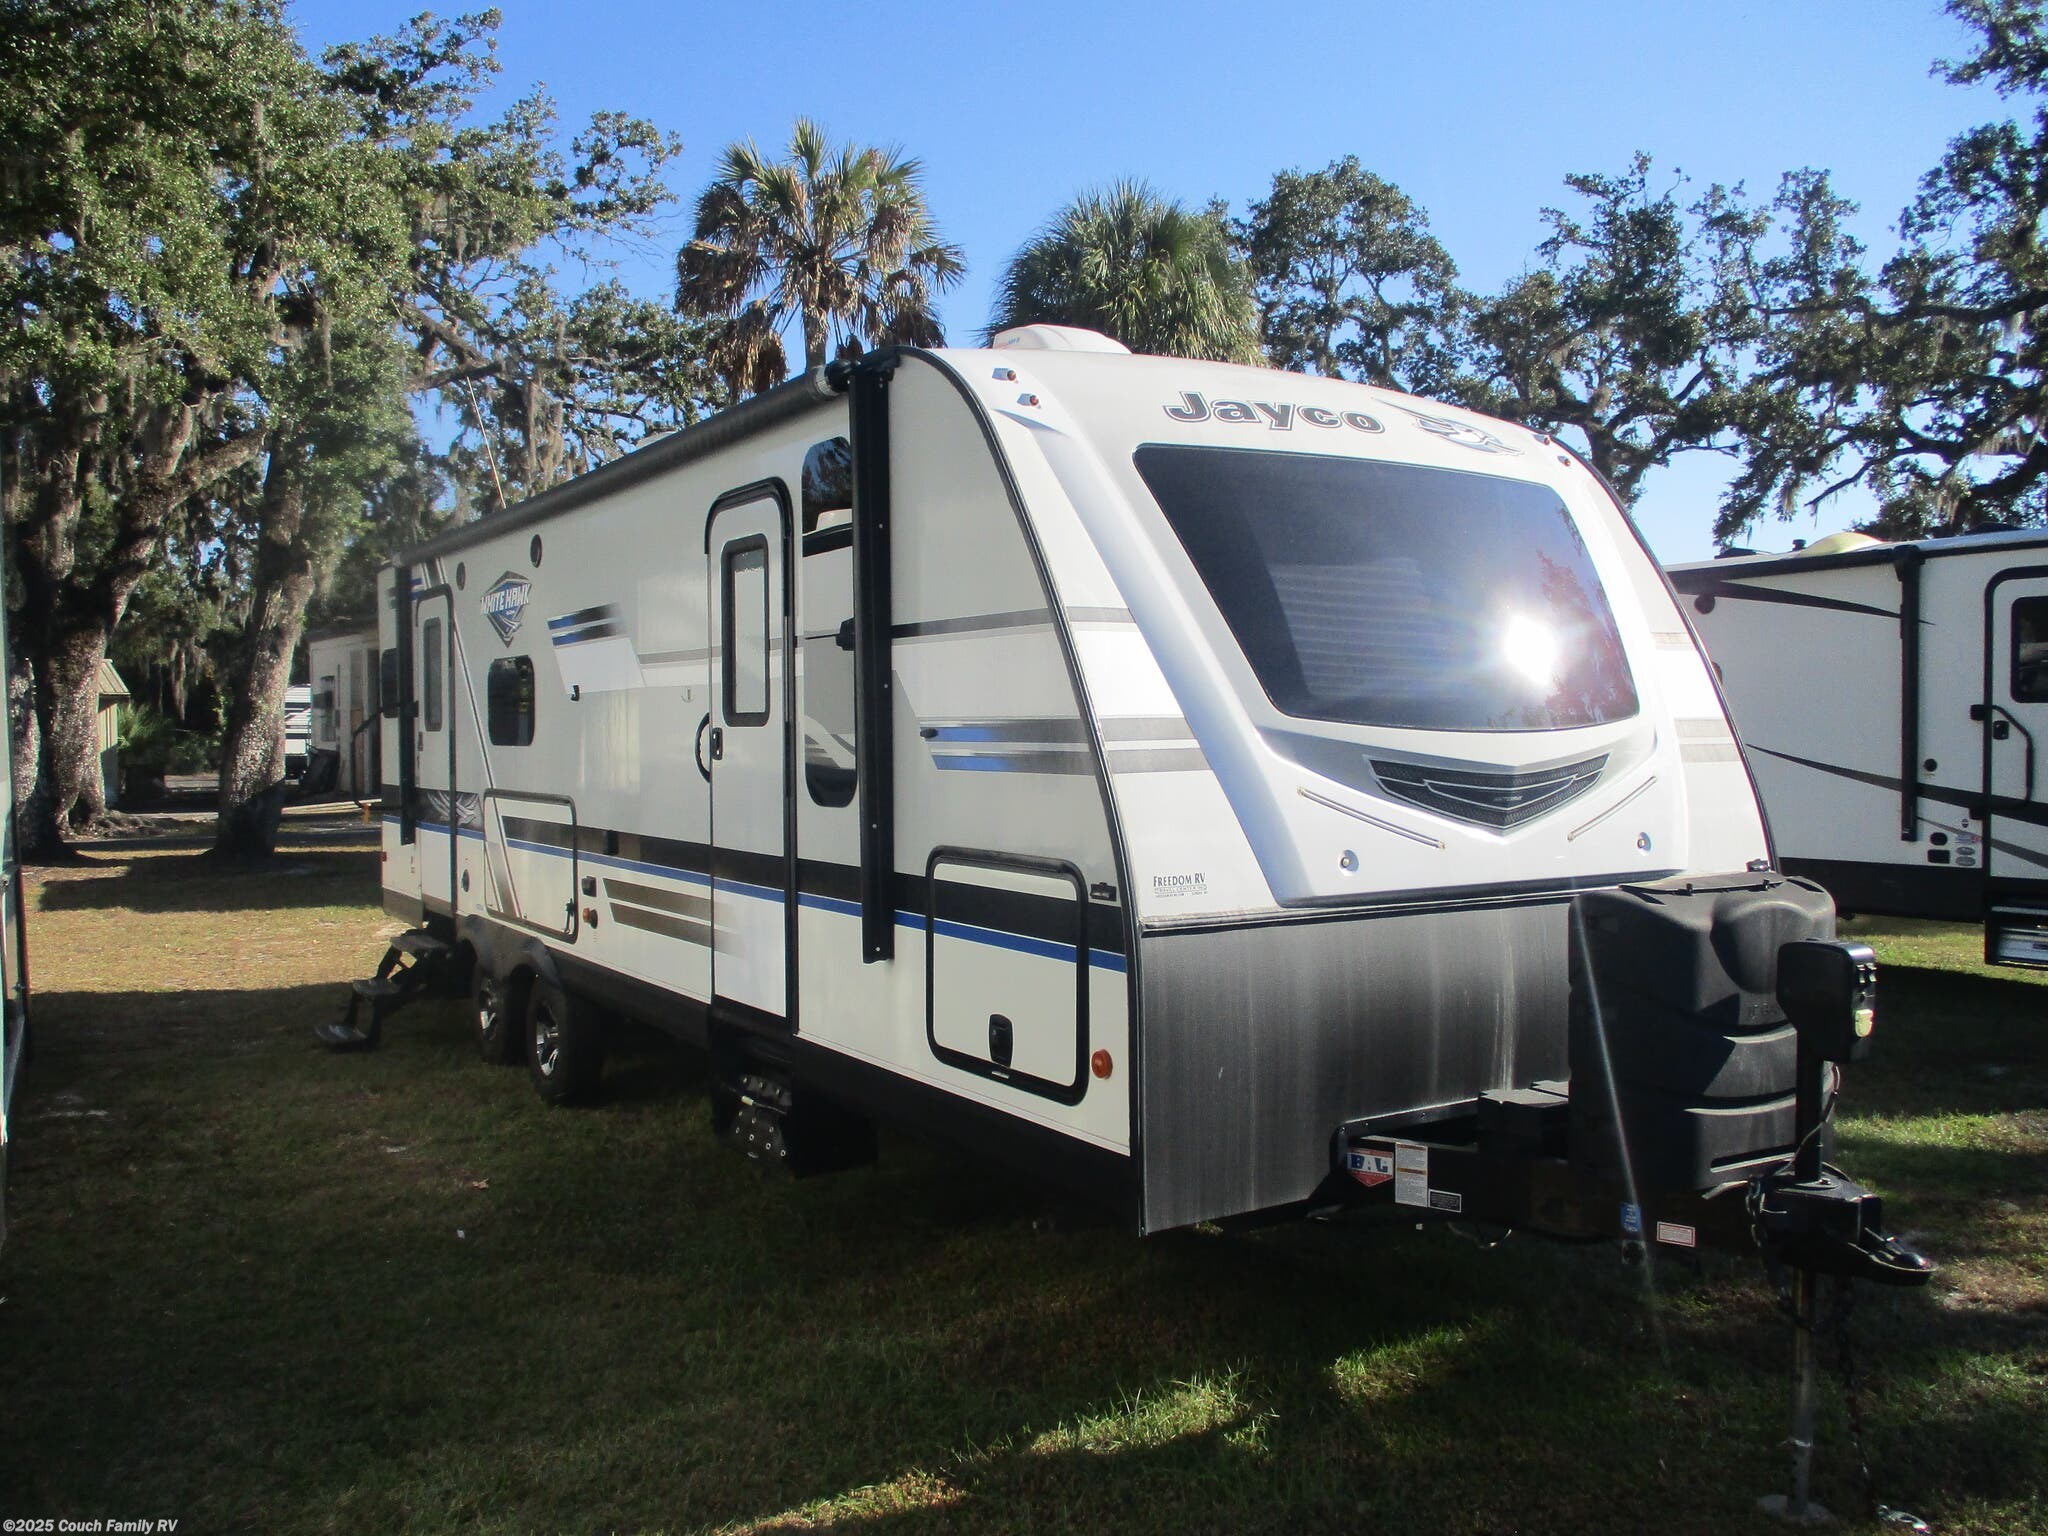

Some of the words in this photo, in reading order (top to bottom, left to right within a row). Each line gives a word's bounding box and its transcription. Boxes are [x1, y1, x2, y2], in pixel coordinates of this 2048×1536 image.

[1162, 390, 1385, 433] Jayco
[480, 591, 505, 615] WHITE
[505, 584, 531, 609] HAWK
[1153, 874, 1192, 887] FREEDOM
[1194, 872, 1206, 884] RV
